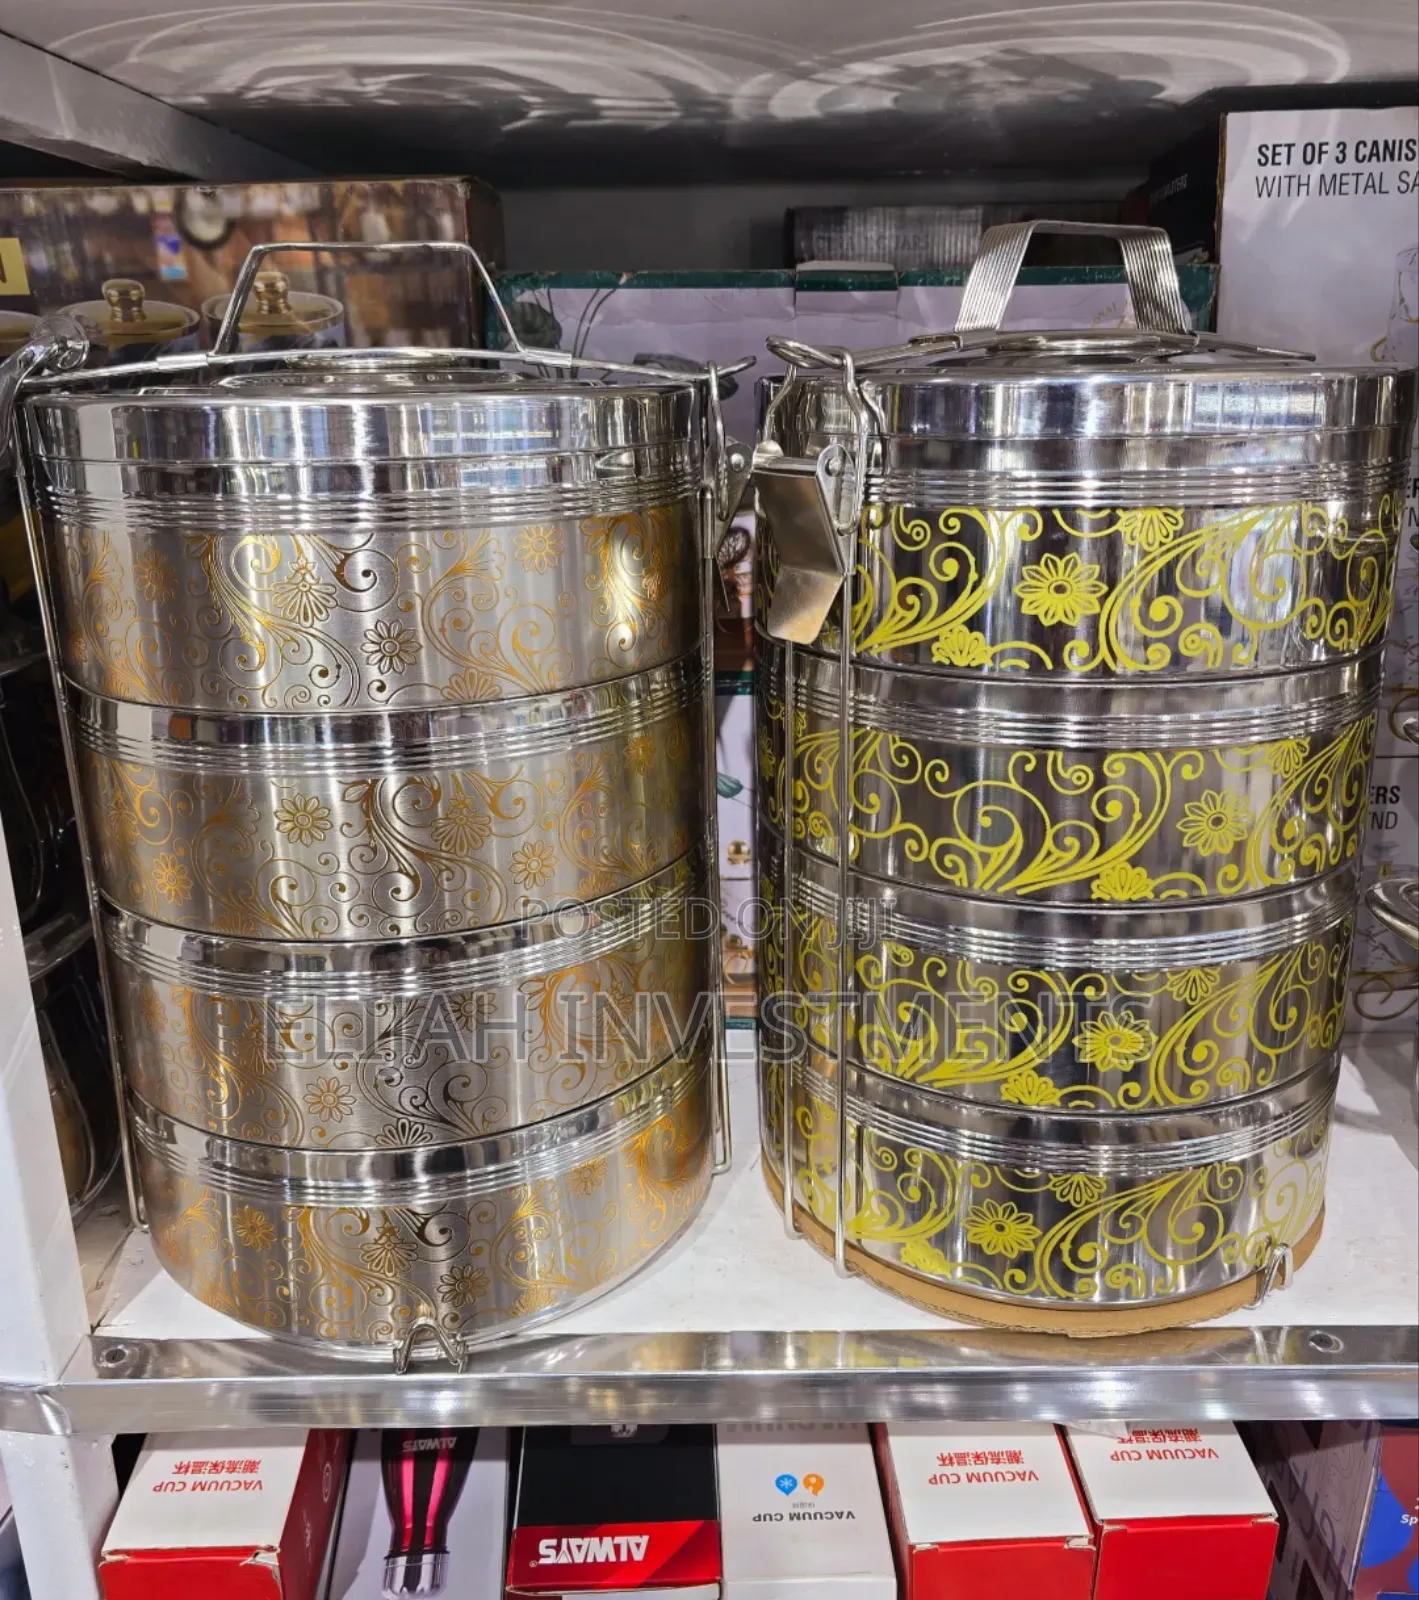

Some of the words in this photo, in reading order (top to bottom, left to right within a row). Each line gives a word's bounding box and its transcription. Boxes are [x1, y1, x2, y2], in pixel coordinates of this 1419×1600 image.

[1257, 143, 1295, 167] SET
[1302, 142, 1329, 165] OF
[1335, 141, 1347, 164] 3
[1354, 138, 1417, 164] CANIS
[1255, 174, 1311, 198] WITH
[1318, 171, 1389, 196] METAL
[1368, 811, 1398, 830] ND
[402, 1436, 458, 1453] ALWAYS
[936, 1450, 1025, 1467] 潮流保温杯
[1110, 1449, 1142, 1462] CUP
[1146, 1448, 1220, 1461] VACUUM
[171, 1459, 262, 1475] 潮流保温杯
[928, 1473, 961, 1486] CUP
[965, 1470, 1039, 1484] VACUUM
[152, 1481, 187, 1493] CUP
[191, 1479, 264, 1492] VACUUM
[751, 1512, 784, 1523] CUP
[788, 1510, 856, 1522] VACUUM
[537, 1534, 650, 1565] ALWAYS
